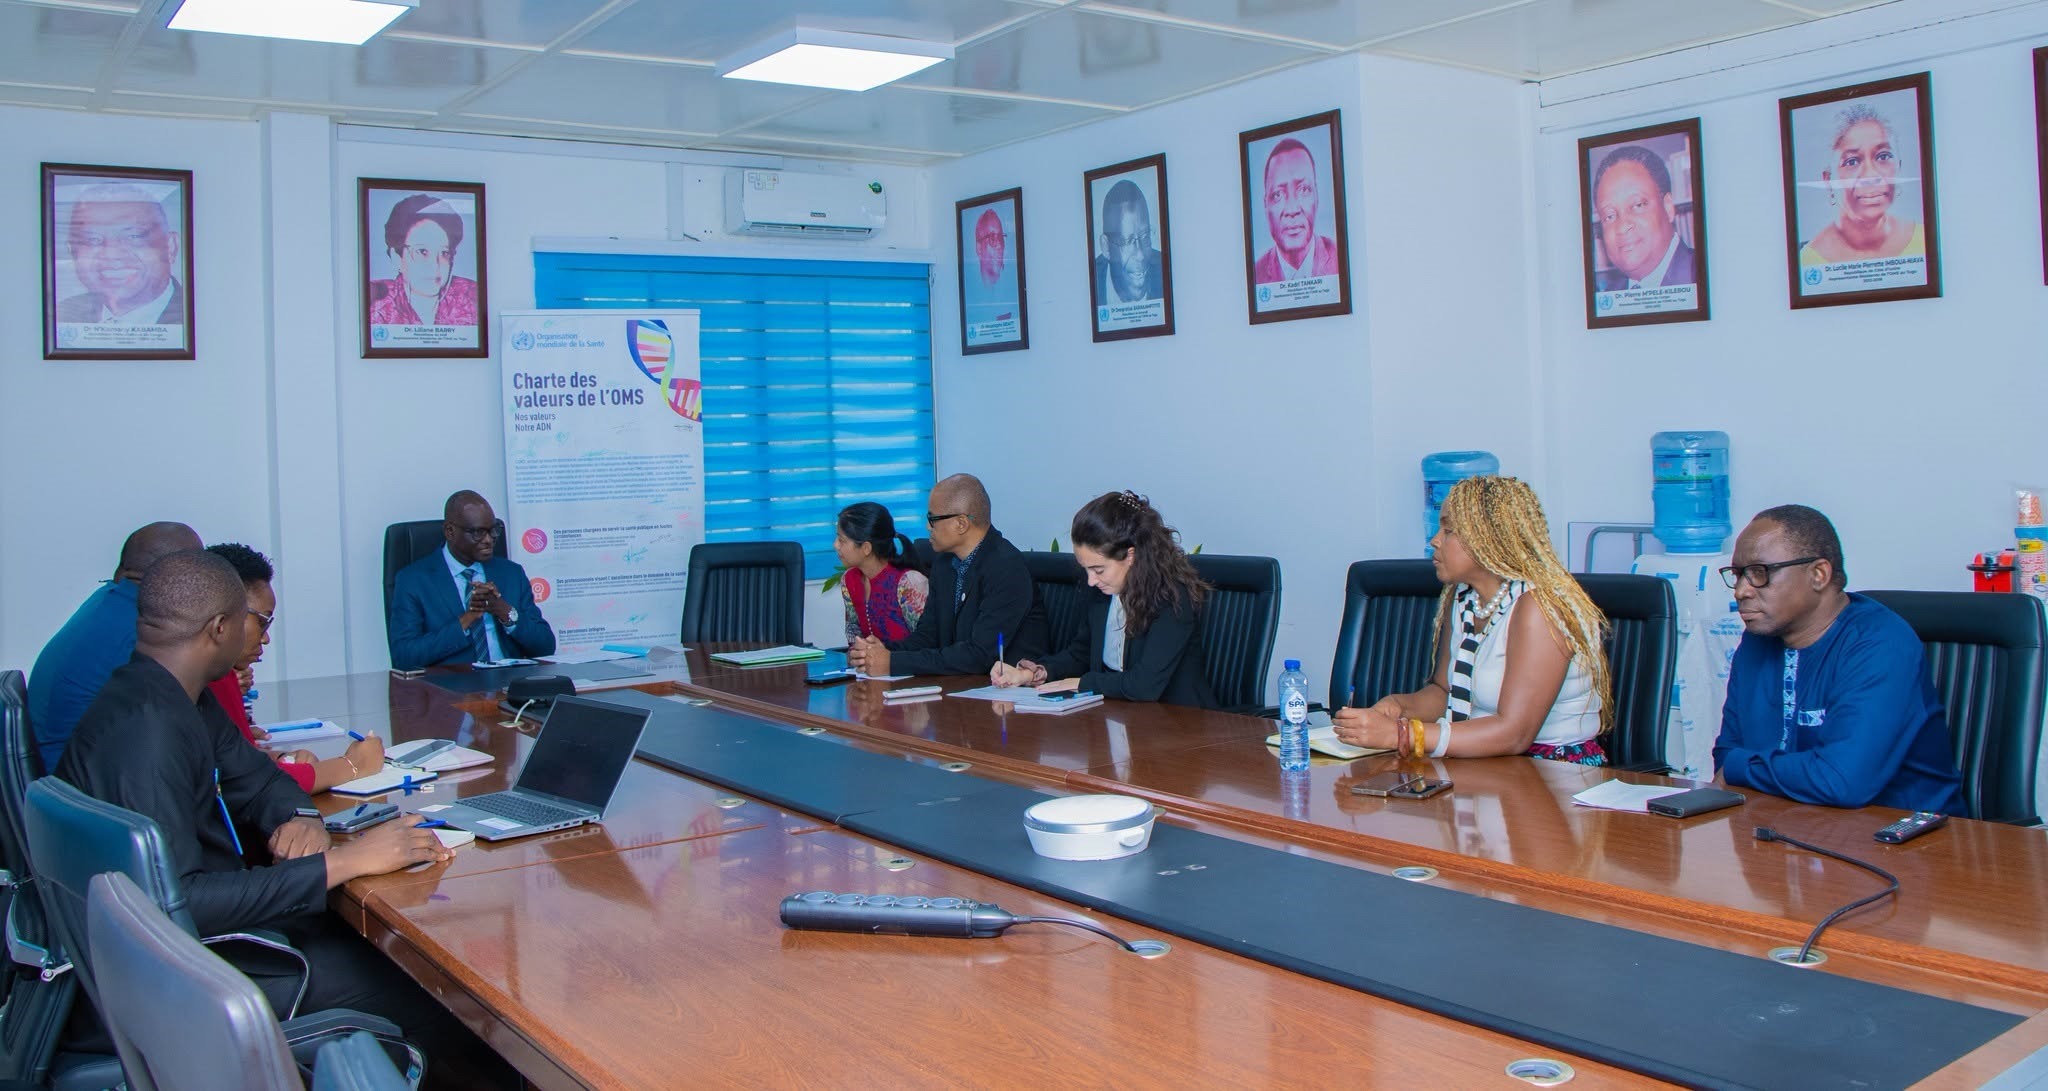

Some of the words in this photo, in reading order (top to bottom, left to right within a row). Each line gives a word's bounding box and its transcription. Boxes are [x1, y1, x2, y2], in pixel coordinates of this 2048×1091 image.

[537, 333, 577, 342] Organisation
[513, 372, 566, 389] Charte
[570, 372, 597, 388] des
[514, 391, 574, 408] valeurs
[578, 390, 596, 406] de
[600, 388, 644, 406] l'OMS
[515, 413, 528, 421] Nos
[530, 412, 556, 420] valeurs
[515, 423, 534, 432] Notre
[536, 423, 551, 431] ADN
